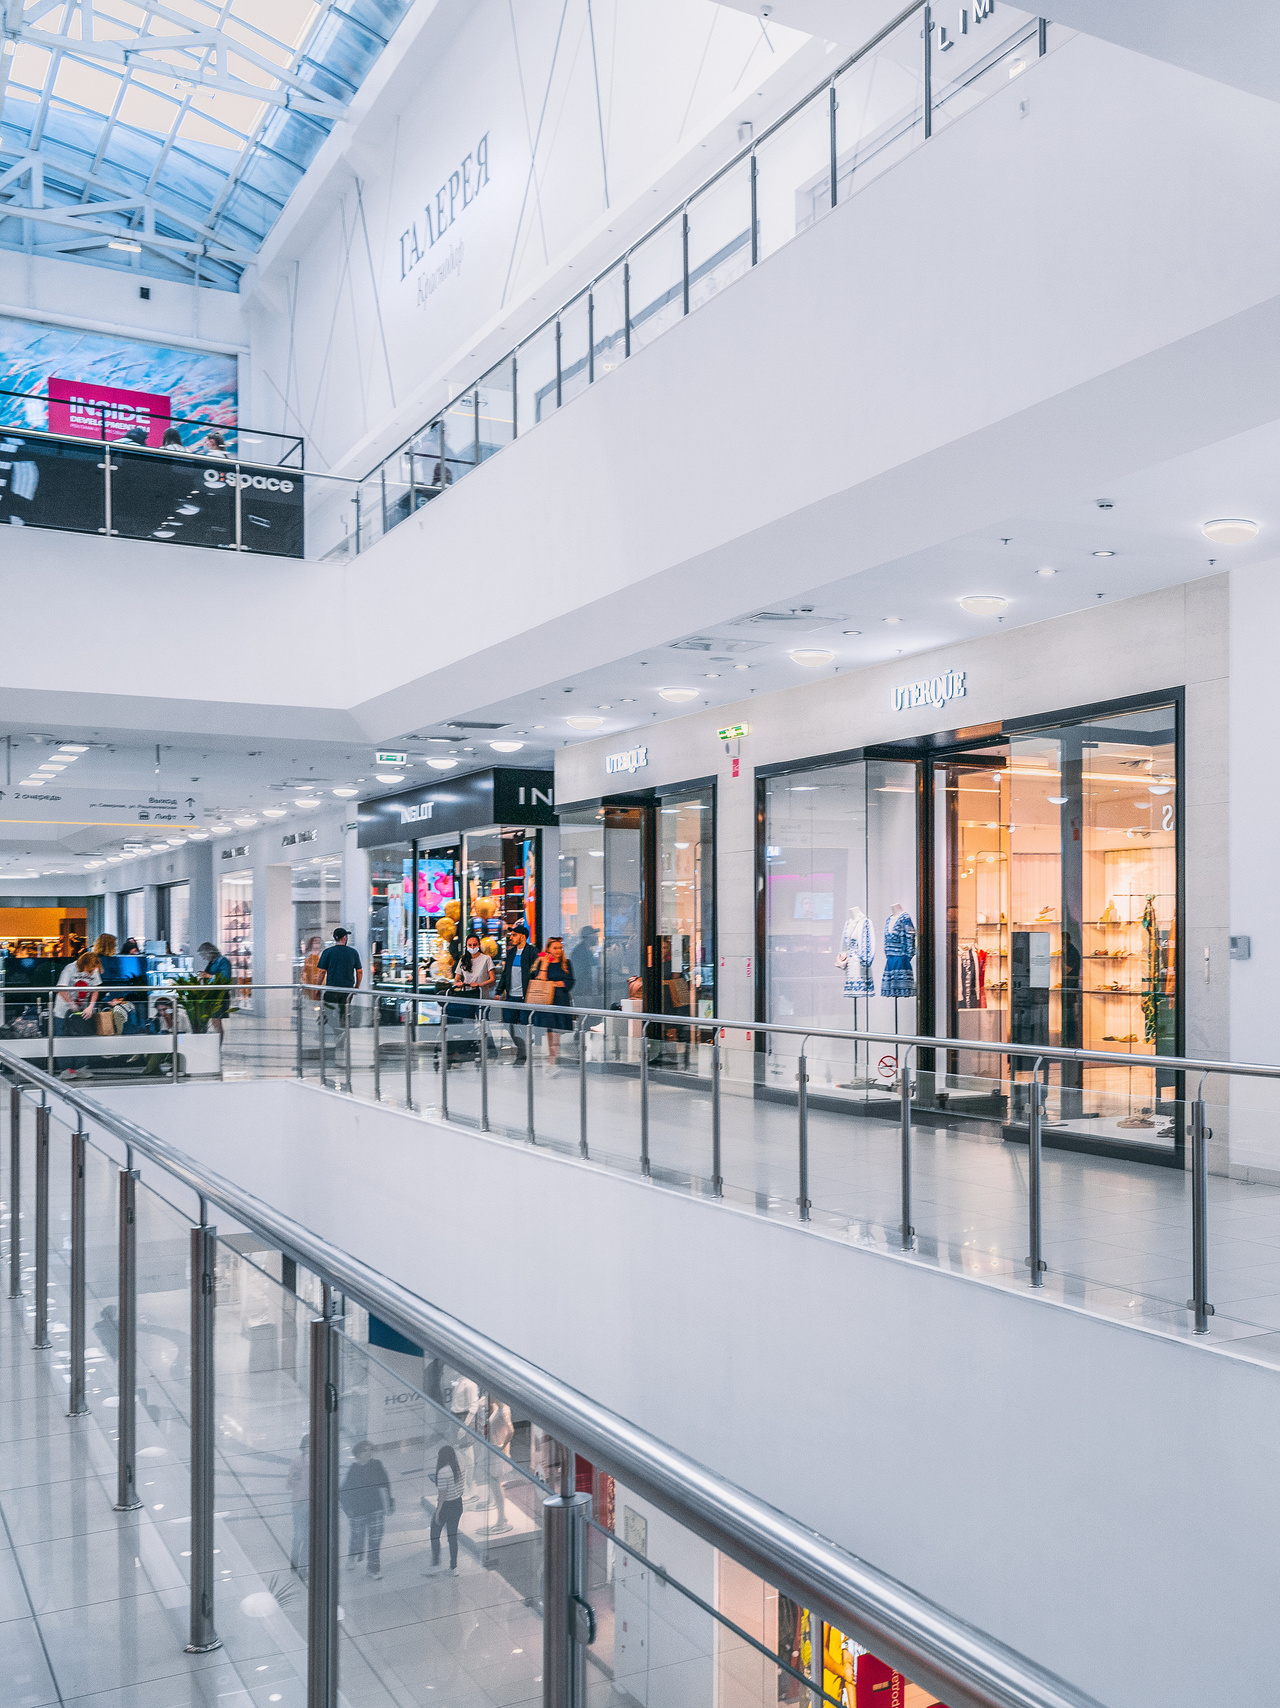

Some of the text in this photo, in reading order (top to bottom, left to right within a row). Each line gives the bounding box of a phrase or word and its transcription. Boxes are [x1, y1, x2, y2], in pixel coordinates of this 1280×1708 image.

[400, 130, 490, 282] ГАЛЕРЕЯ
[69, 395, 151, 425] INSIDE
[69, 415, 151, 433] DEVELOPMENTRU
